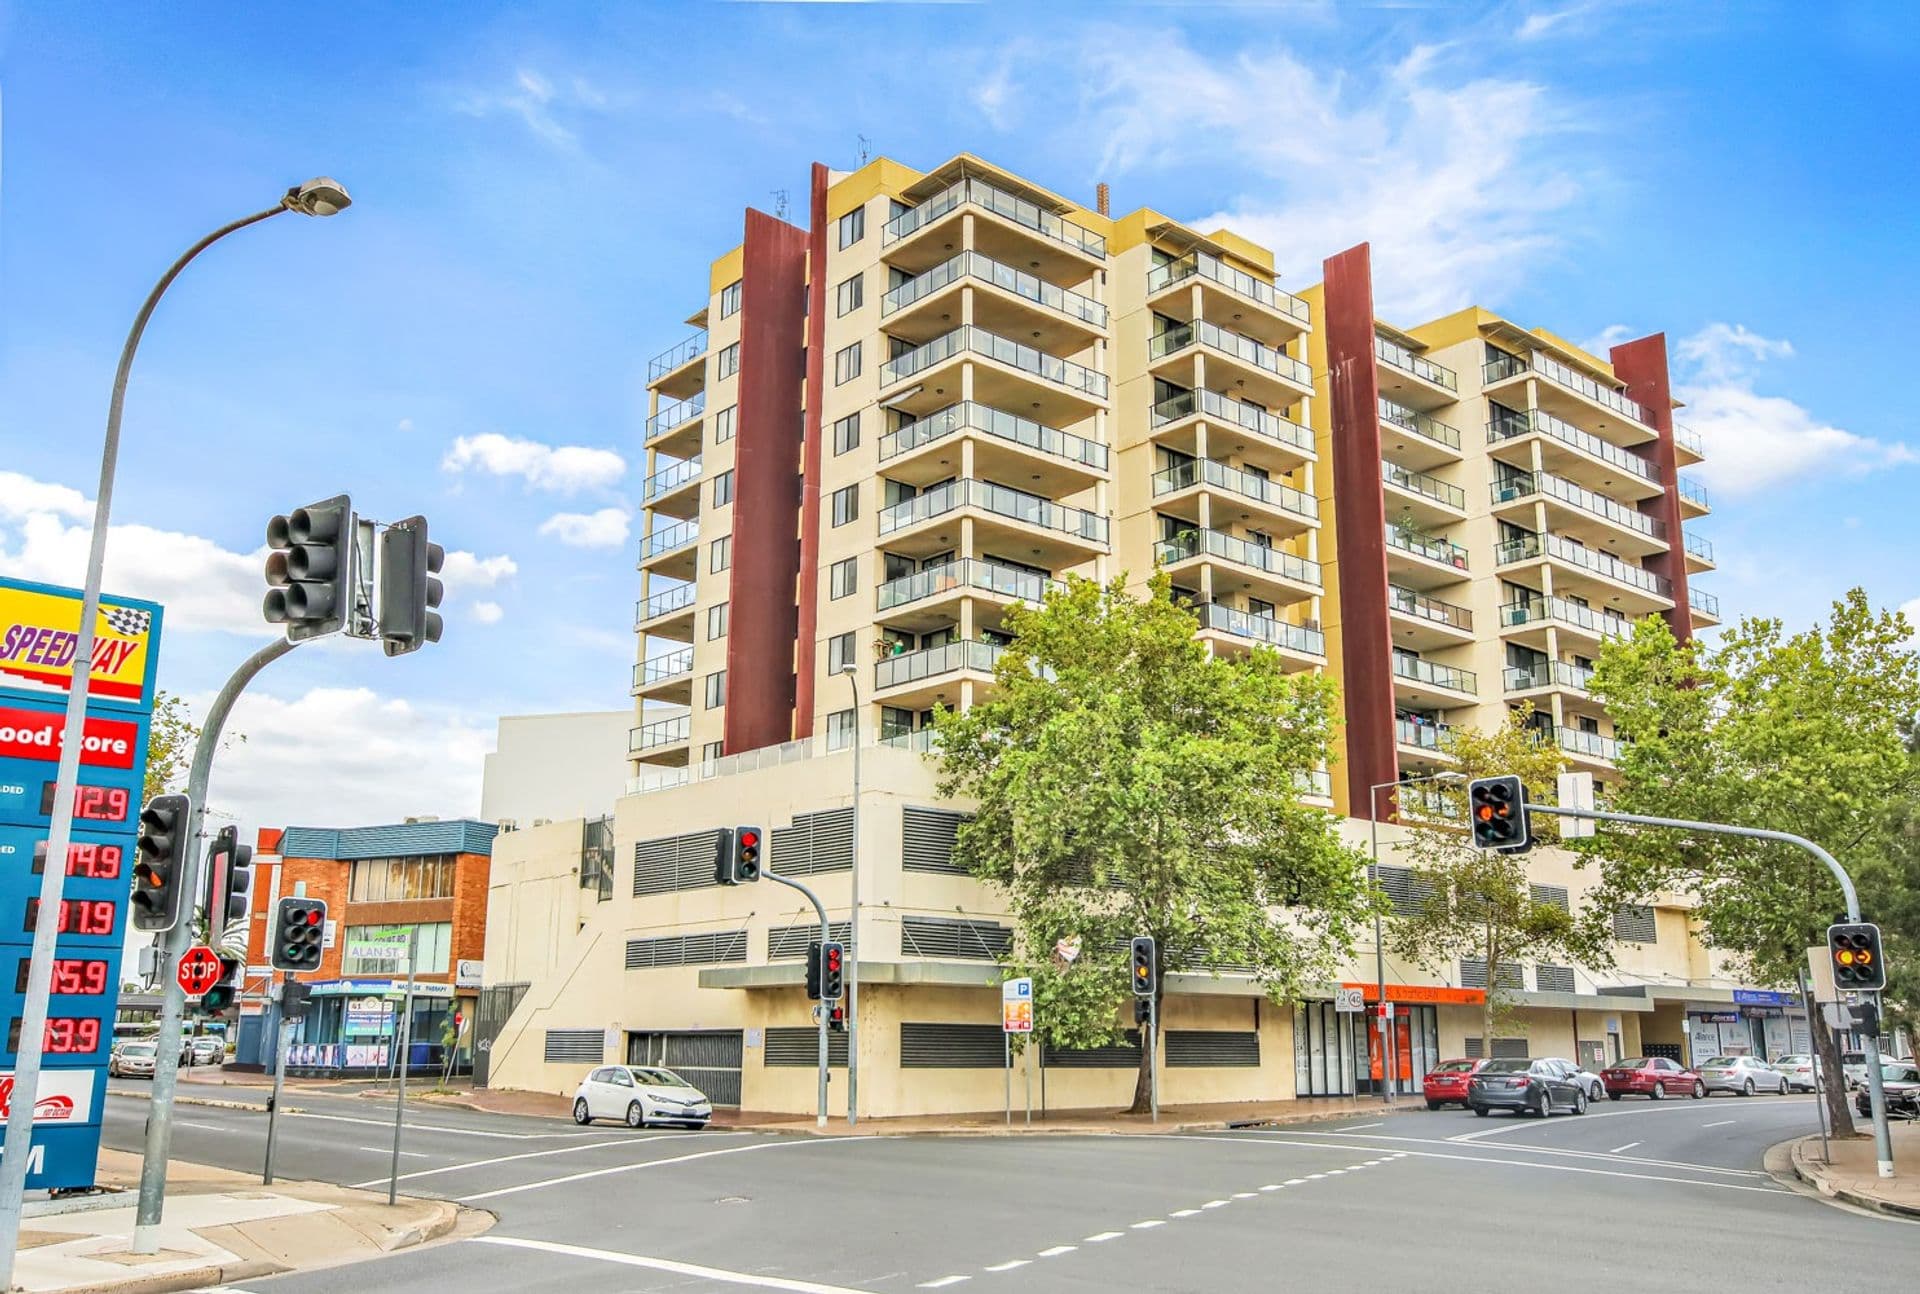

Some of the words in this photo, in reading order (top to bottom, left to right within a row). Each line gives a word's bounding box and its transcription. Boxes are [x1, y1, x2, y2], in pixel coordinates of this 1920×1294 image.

[352, 946, 383, 957] ALAN
[181, 961, 216, 980] STOP
[1020, 984, 1028, 994] P
[1351, 994, 1361, 1003] 40
